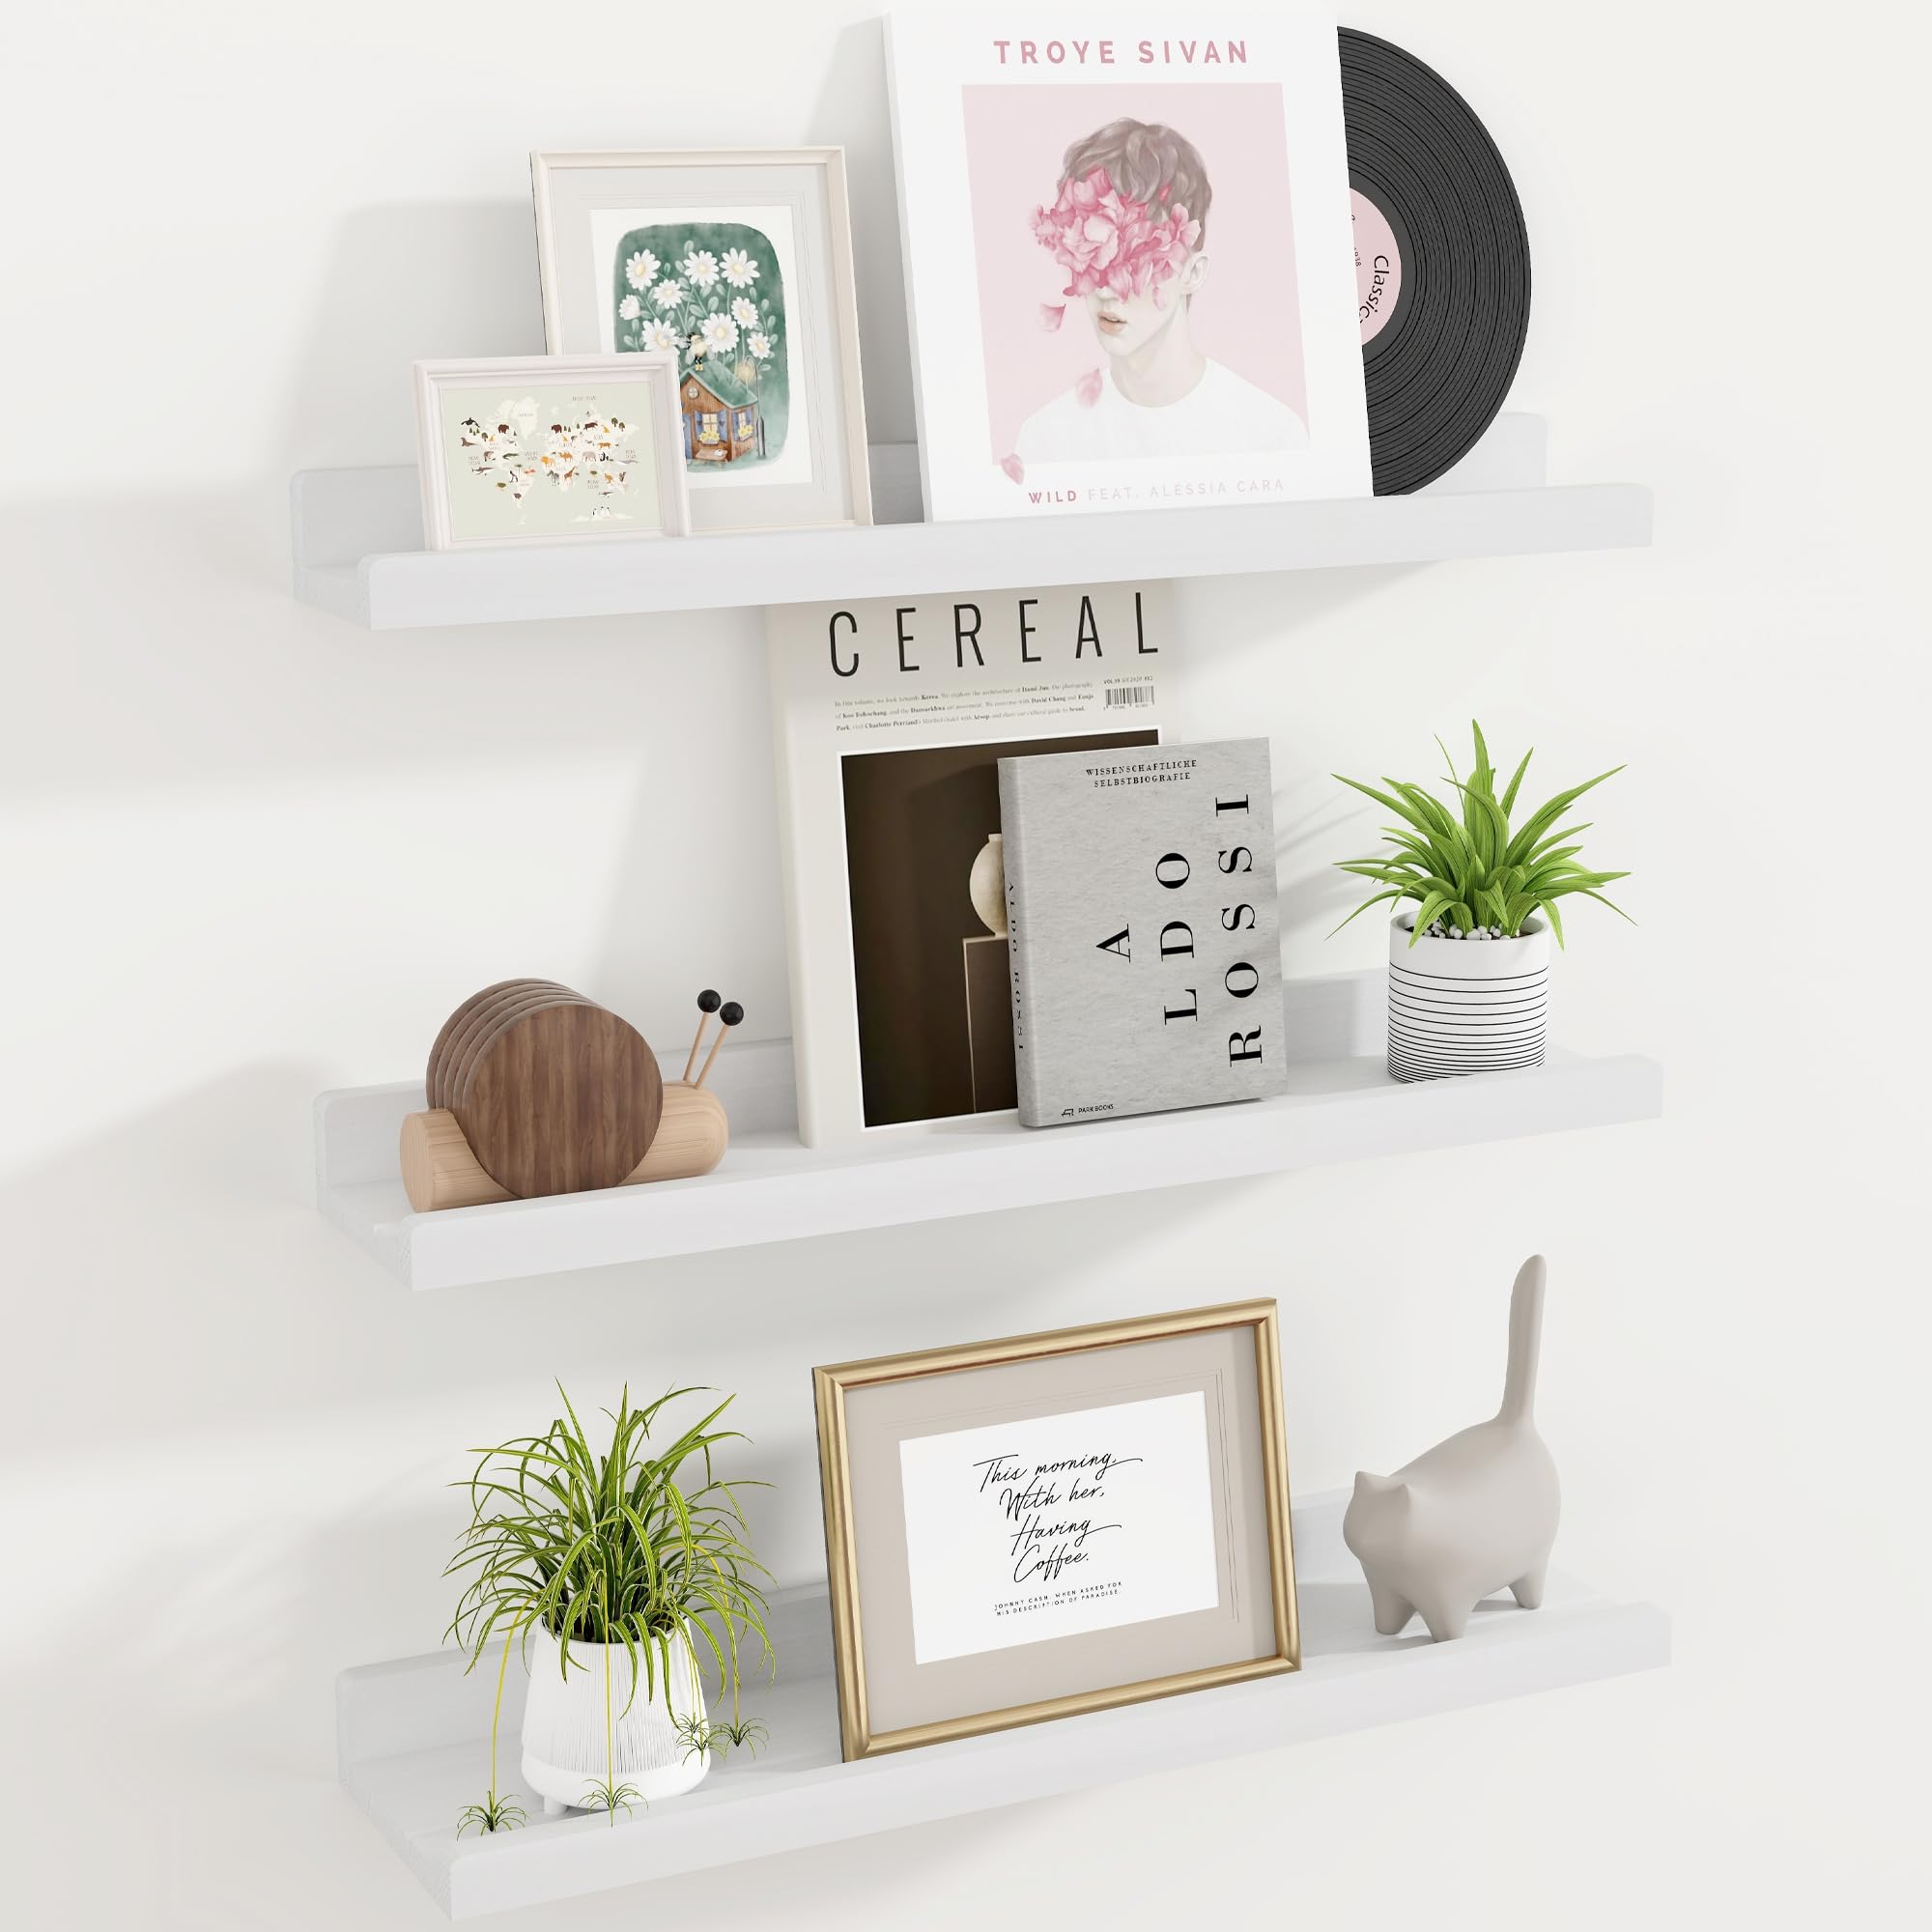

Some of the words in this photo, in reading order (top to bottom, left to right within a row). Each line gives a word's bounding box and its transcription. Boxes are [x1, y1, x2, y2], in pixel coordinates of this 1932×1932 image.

[993, 40, 1115, 64] TROYE
[1138, 40, 1247, 64] SIVAN
[1357, 255, 1389, 324] Classic
[1028, 490, 1077, 504] WILD
[1088, 486, 1139, 501] FEAT.
[1150, 482, 1228, 498] ALESSIA
[1236, 478, 1285, 494] CARA
[829, 592, 1159, 678] CEREAL
[1086, 759, 1198, 777] WISSENSCHAFTLICHE
[1094, 772, 1191, 788] SELBSTBIOGRAFIE
[1095, 923, 1131, 963] A
[1155, 852, 1198, 1025] LDO
[1215, 794, 1263, 1067] ROSSI
[1094, 1103, 1114, 1112] BOOKS
[973, 1453, 1028, 1493] This
[1035, 1452, 1144, 1481] morning,
[999, 1475, 1062, 1521] With
[1068, 1477, 1105, 1503] her,
[1009, 1513, 1122, 1557] Having
[1013, 1542, 1090, 1583] Coffee.
[994, 1600, 1024, 1611] JOHNNY
[1055, 1589, 1076, 1598] WHEN
[1080, 1584, 1105, 1594] ASKED
[1012, 1599, 1065, 1614] DESCRIPTION
